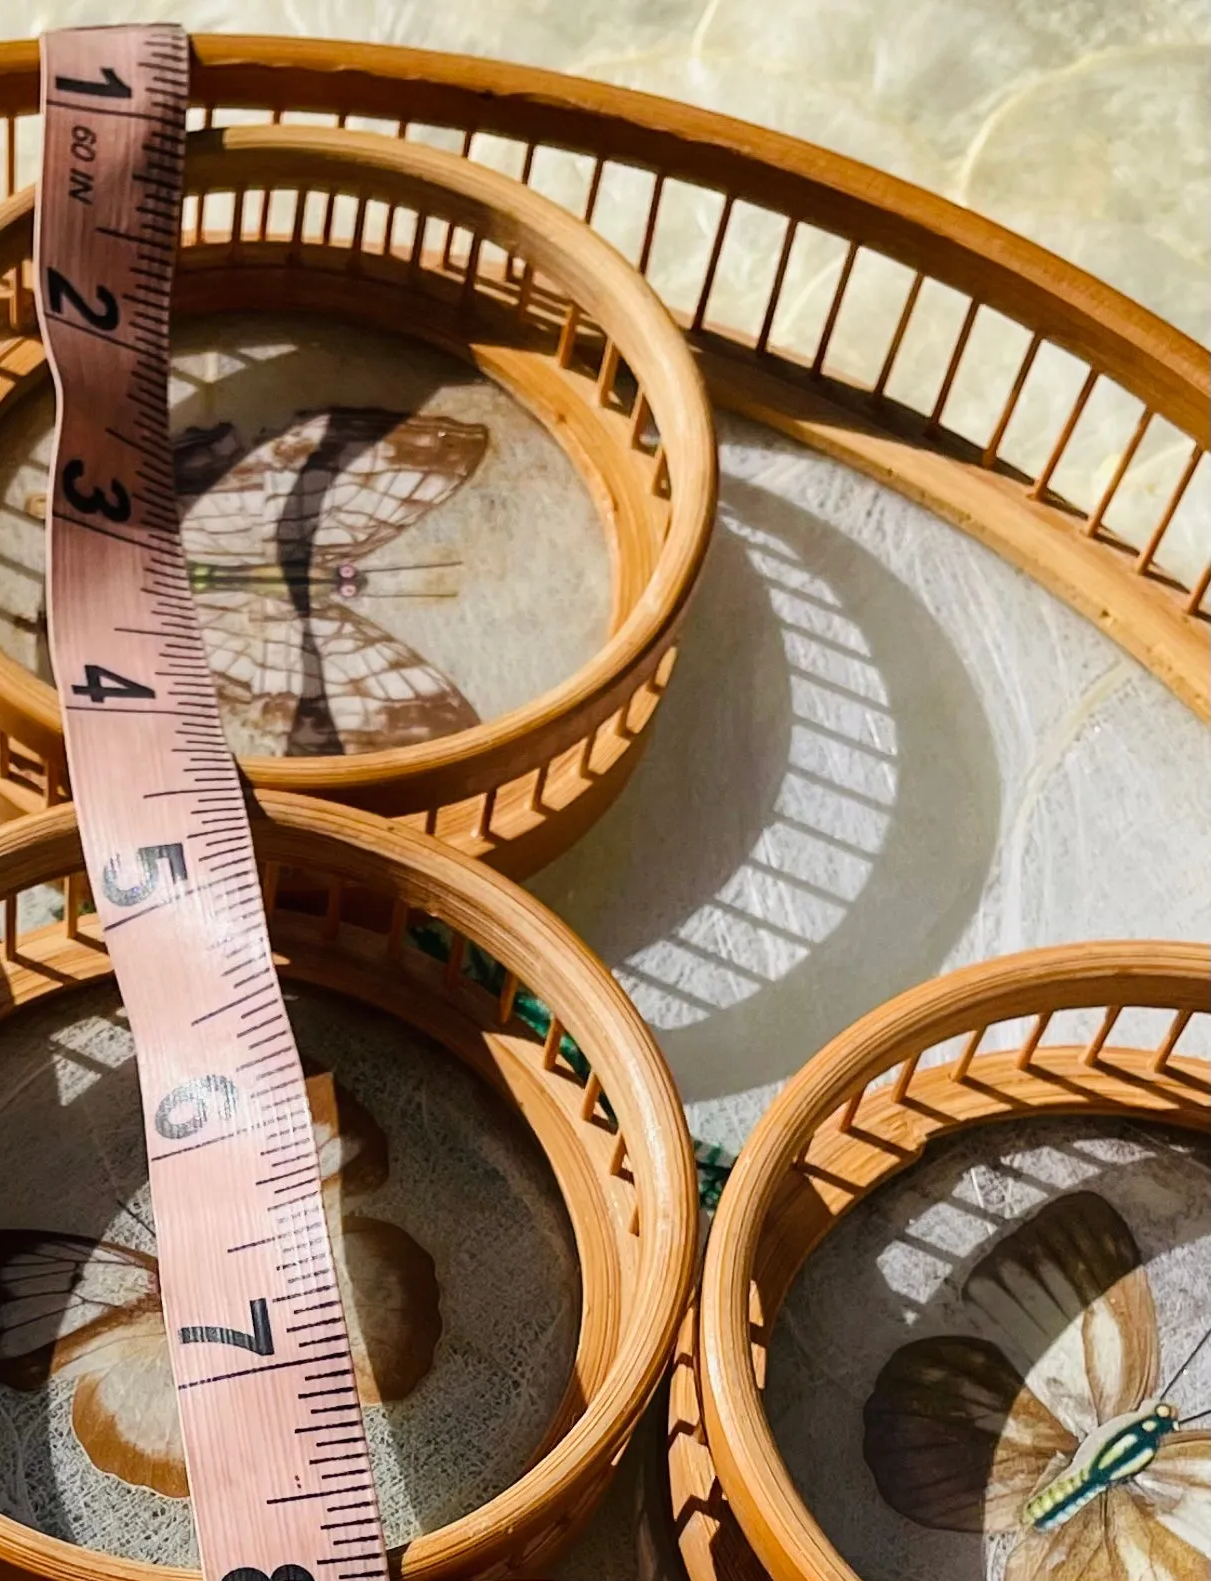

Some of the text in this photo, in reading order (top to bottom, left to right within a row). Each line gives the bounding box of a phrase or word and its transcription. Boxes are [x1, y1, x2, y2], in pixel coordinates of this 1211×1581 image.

[55, 67, 132, 99] 1
[68, 125, 98, 205] 60 IN
[47, 266, 119, 331] 2
[61, 459, 131, 525] 3
[71, 665, 156, 704] 4
[102, 843, 188, 907] 5
[154, 1073, 239, 1141] 6
[178, 1298, 274, 1357] 7
